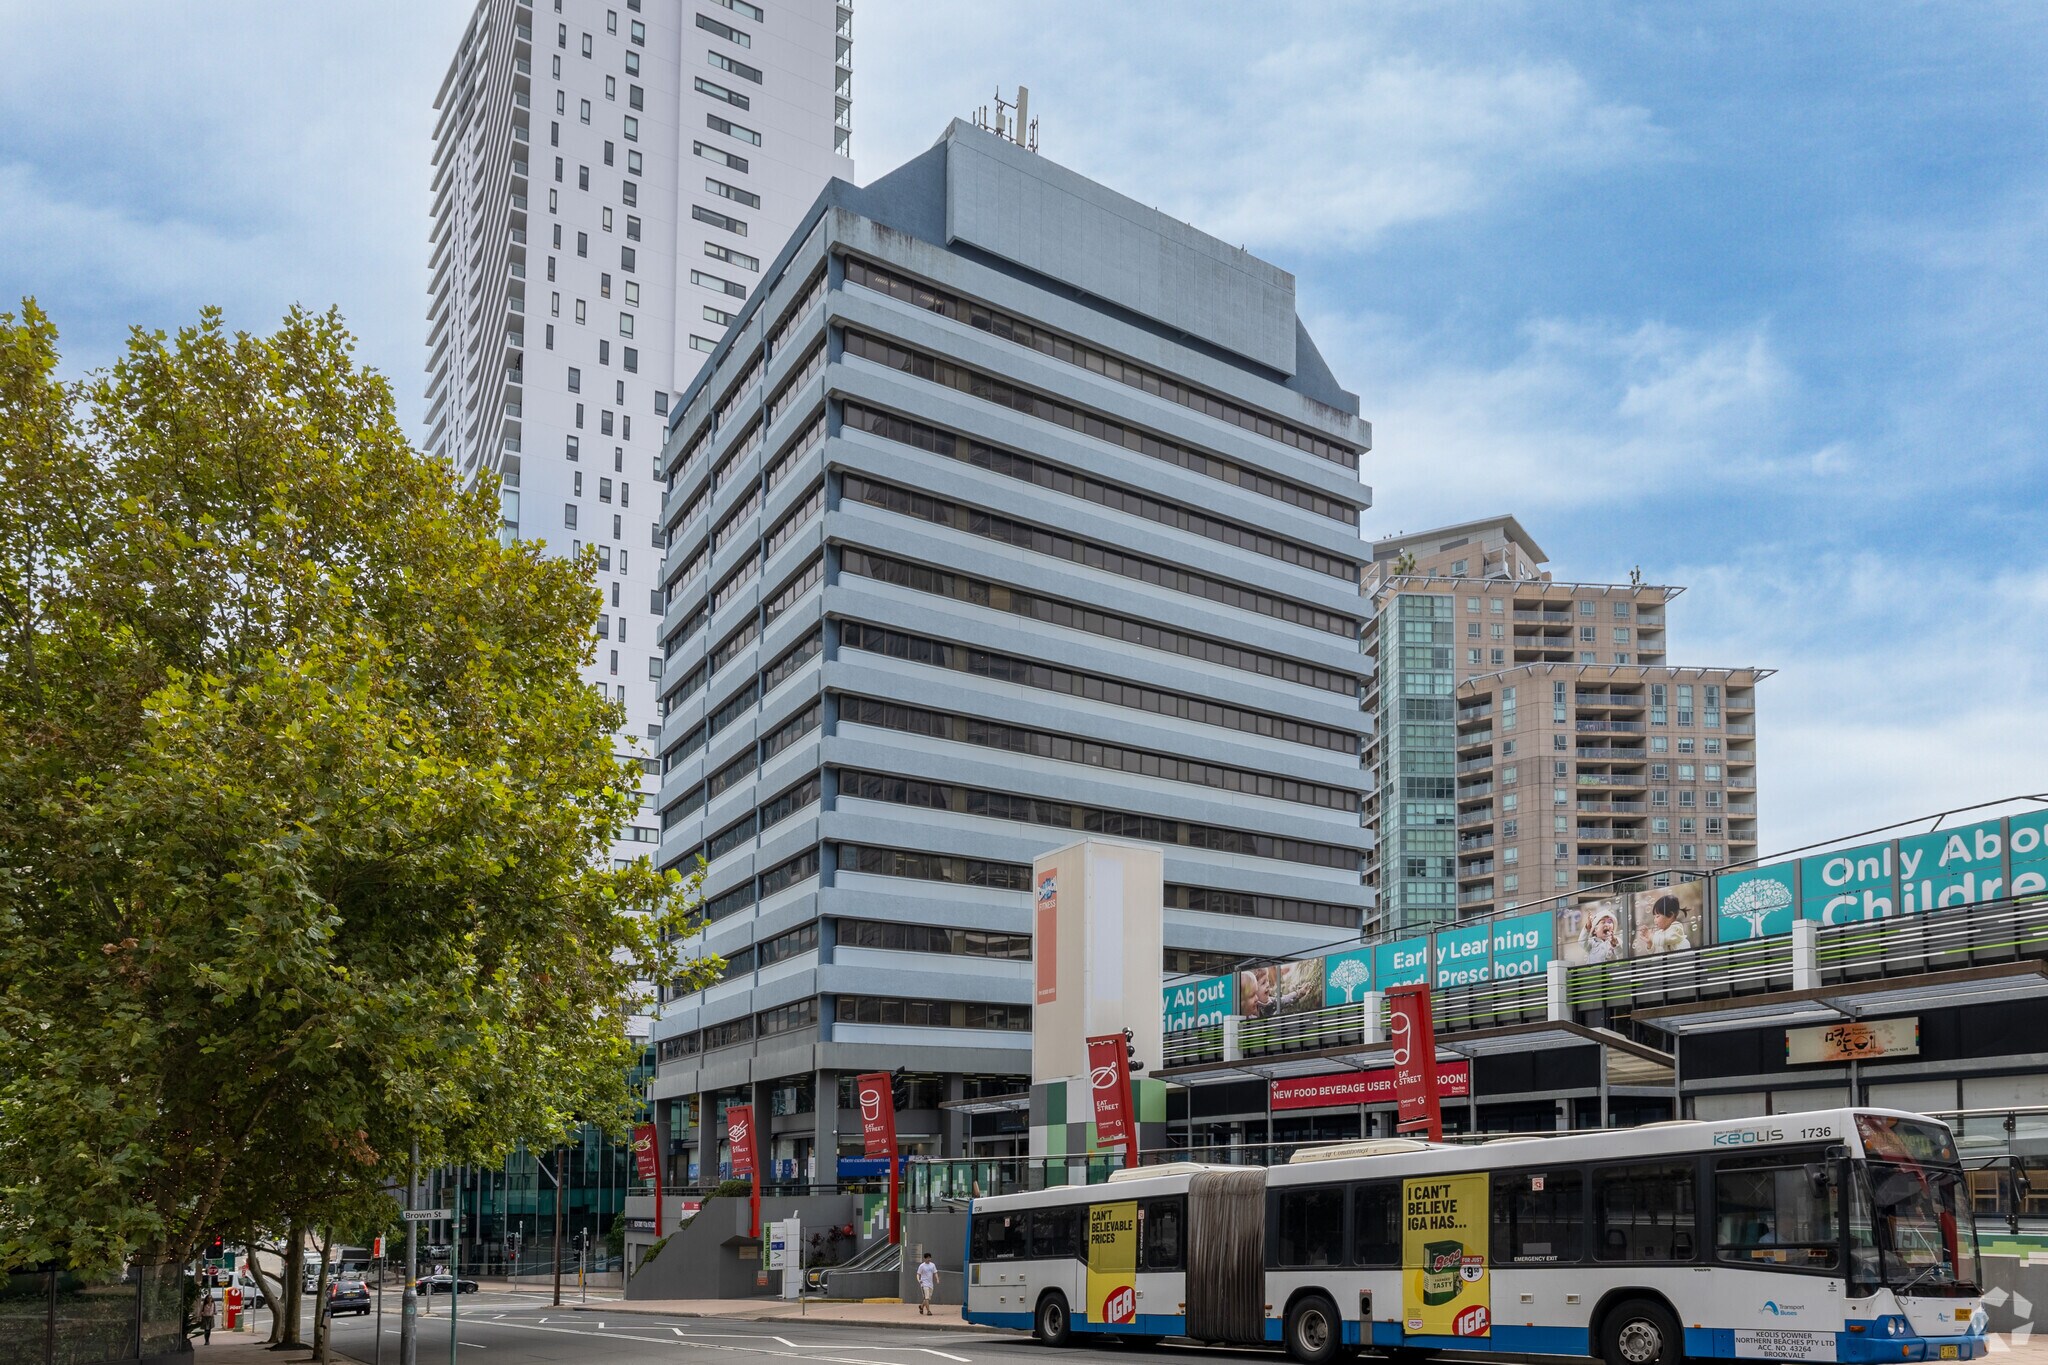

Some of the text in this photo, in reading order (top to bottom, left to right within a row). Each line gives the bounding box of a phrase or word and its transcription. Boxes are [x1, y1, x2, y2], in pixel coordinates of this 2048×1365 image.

[1822, 829, 2048, 887] Only Abo
[1822, 872, 2048, 926] Childre
[1393, 930, 1539, 969] Early Learning
[1439, 954, 1539, 987] Preschool
[1173, 981, 1225, 1008] About
[1398, 1070, 1409, 1079] EAT
[1399, 1074, 1422, 1086] STREET
[1273, 1090, 1293, 1099] NEW
[1294, 1087, 1317, 1098] FOOD
[1319, 1083, 1365, 1096] BEVERAGE
[1367, 1081, 1391, 1092] USER
[1097, 1103, 1119, 1112] STREET
[1801, 1126, 1831, 1138] 1736
[1408, 1184, 1451, 1200] I CAN'T
[1091, 1210, 1113, 1221] CAN'T
[1408, 1199, 1458, 1216] BELIEVE
[1091, 1220, 1133, 1233] BELIEVABLE
[1408, 1215, 1467, 1231] IGA HAS...
[1091, 1233, 1116, 1245] PRICES
[1433, 1249, 1462, 1273] Bega
[1433, 1281, 1453, 1289] TASTY
[1107, 1288, 1133, 1323] IGA
[1458, 1306, 1486, 1335] IGA
[1773, 1338, 1805, 1346] BEACHES
[1781, 1332, 1813, 1340] DOWNER
[1764, 1351, 1806, 1359] BROOKVALE
